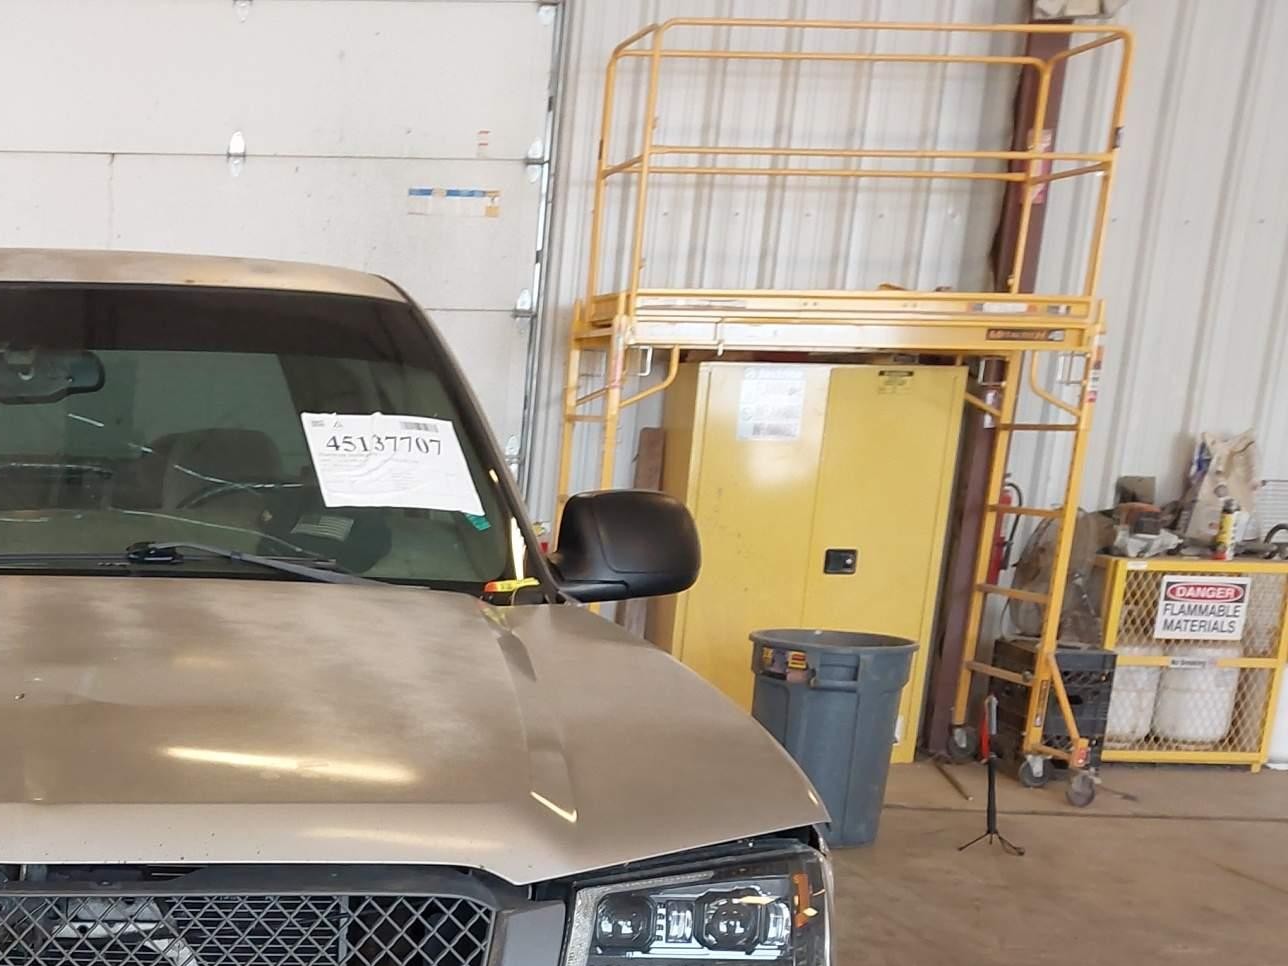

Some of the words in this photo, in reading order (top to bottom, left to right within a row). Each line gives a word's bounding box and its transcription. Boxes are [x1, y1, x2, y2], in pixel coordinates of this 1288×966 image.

[325, 434, 441, 455] 45137707
[1176, 586, 1235, 599] DANGER
[1163, 603, 1240, 618] FLAMMABLE
[1162, 619, 1236, 634] MATERIALS
